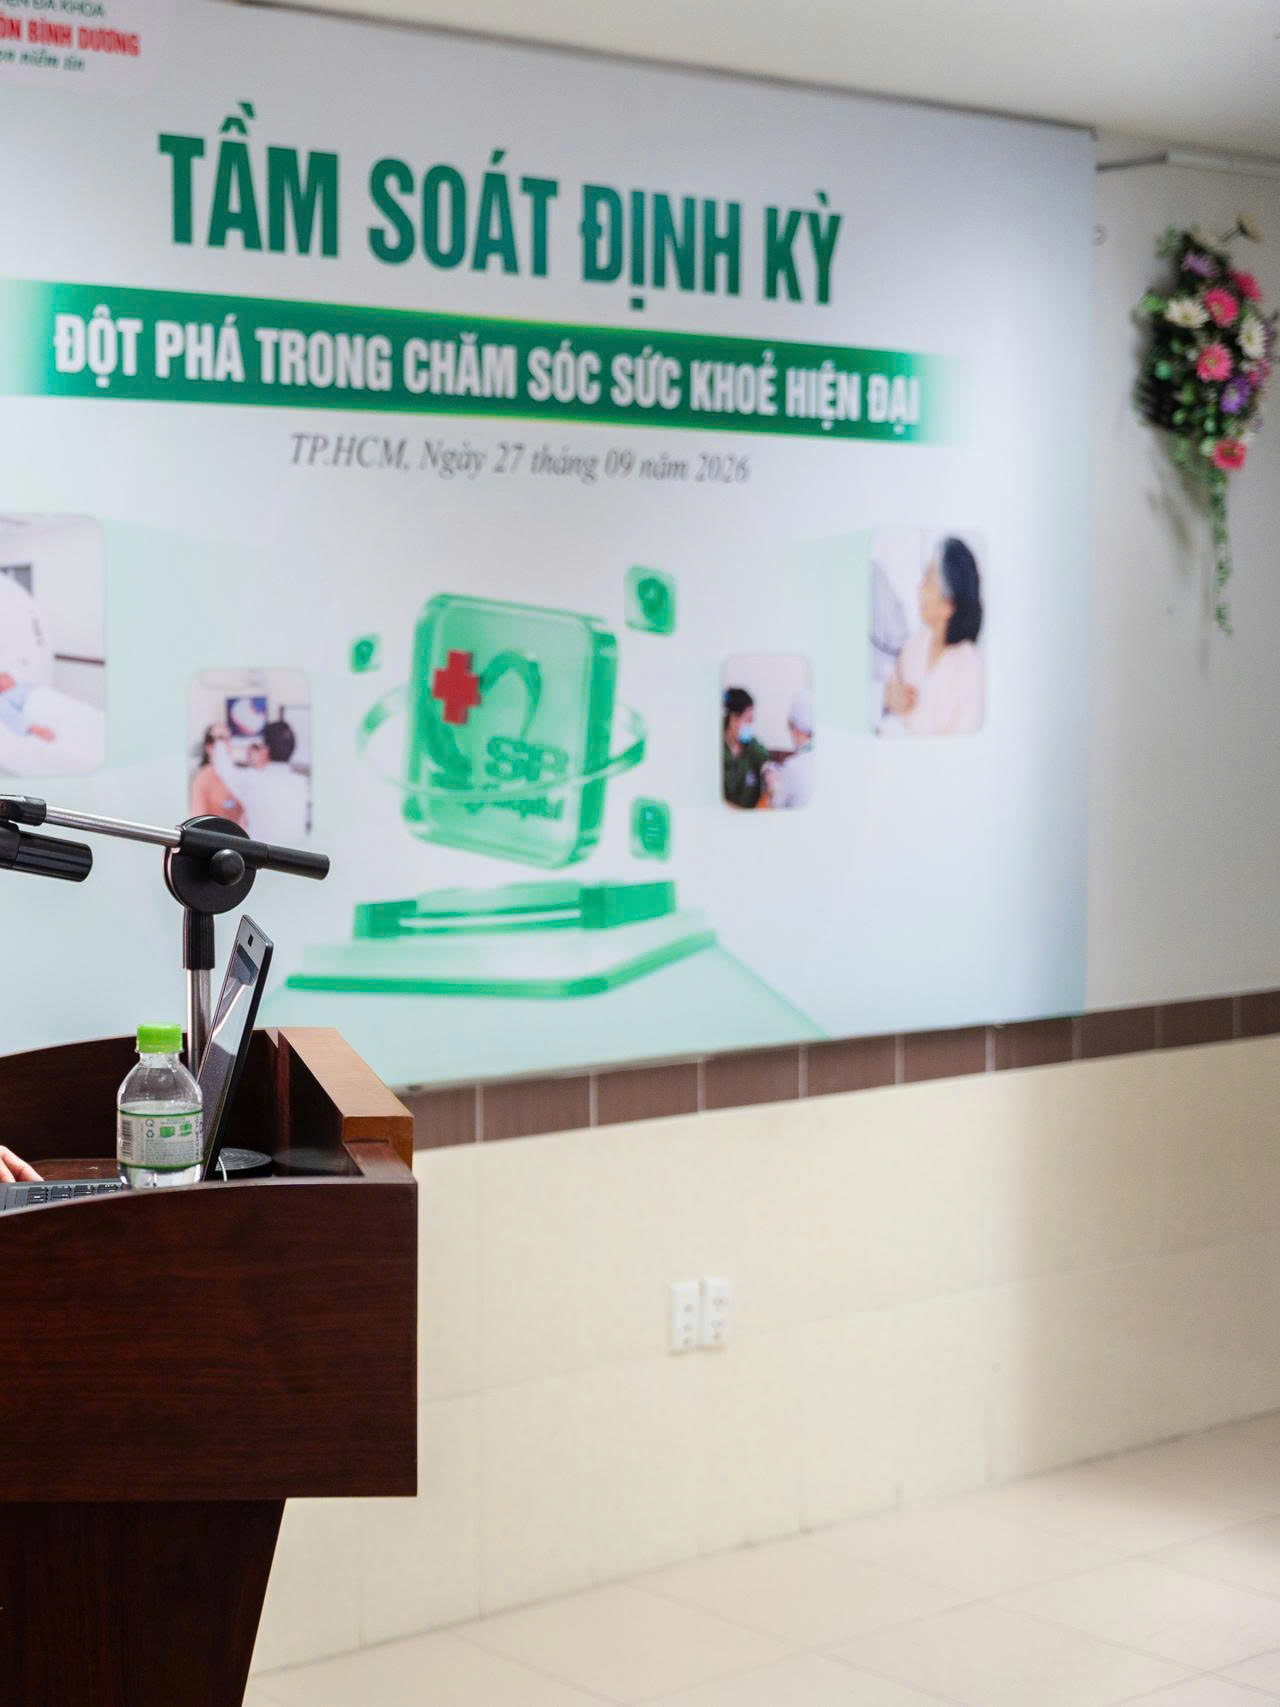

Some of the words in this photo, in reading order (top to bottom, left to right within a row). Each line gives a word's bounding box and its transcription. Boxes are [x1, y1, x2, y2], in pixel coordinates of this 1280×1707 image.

[27, 18, 72, 47] BÌNH
[77, 25, 141, 56] DƯƠNG
[158, 102, 341, 259] TẦM
[368, 149, 560, 278] SOÁT
[582, 183, 741, 311] ĐỊNH
[765, 190, 842, 306] KỲ
[54, 303, 144, 389] ĐỘT
[154, 312, 246, 383] PHÁ
[254, 326, 393, 392] TRONG
[402, 331, 518, 399] CHĂM
[527, 338, 602, 405] SÓC
[610, 345, 682, 410] SỨC
[689, 348, 778, 416] KHOẺ
[785, 360, 861, 430] HIỆN
[867, 372, 920, 435] ĐẠI
[419, 440, 487, 480] Ngày
[493, 440, 526, 474] 27
[531, 445, 599, 485] tháng
[603, 448, 634, 479] 09
[639, 452, 690, 482] năm
[694, 452, 752, 483] 2026
